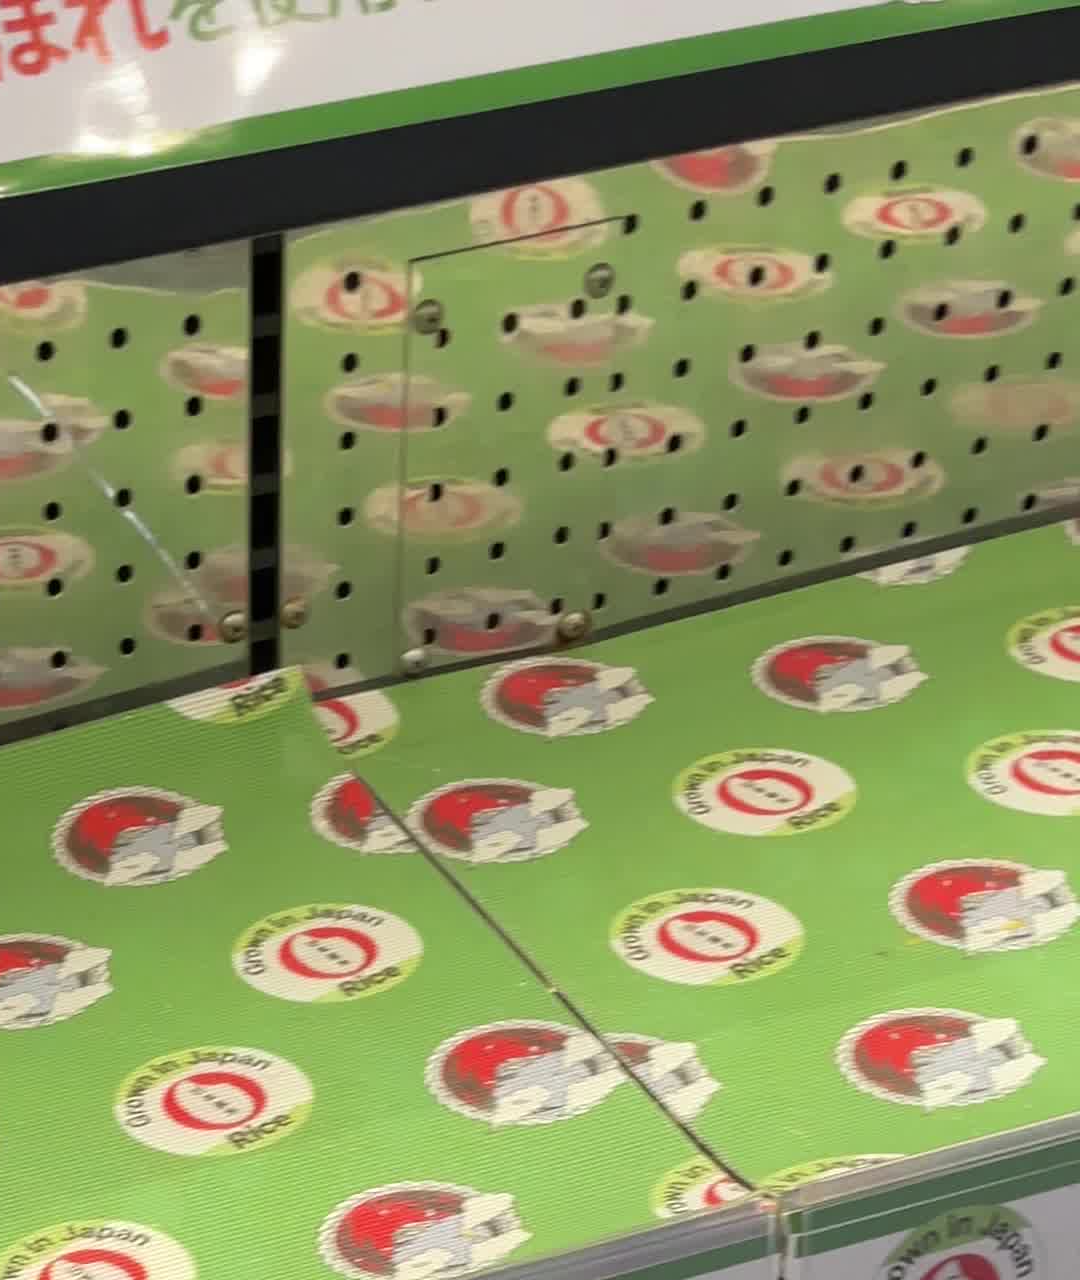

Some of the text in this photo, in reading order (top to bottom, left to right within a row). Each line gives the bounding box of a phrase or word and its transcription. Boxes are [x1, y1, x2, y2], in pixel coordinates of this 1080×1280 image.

[302, 907, 385, 928] Japan
[338, 965, 401, 997] Rice
[187, 1051, 273, 1070] Japan
[225, 1113, 293, 1149] Rice
[62, 1224, 153, 1247] Japan
